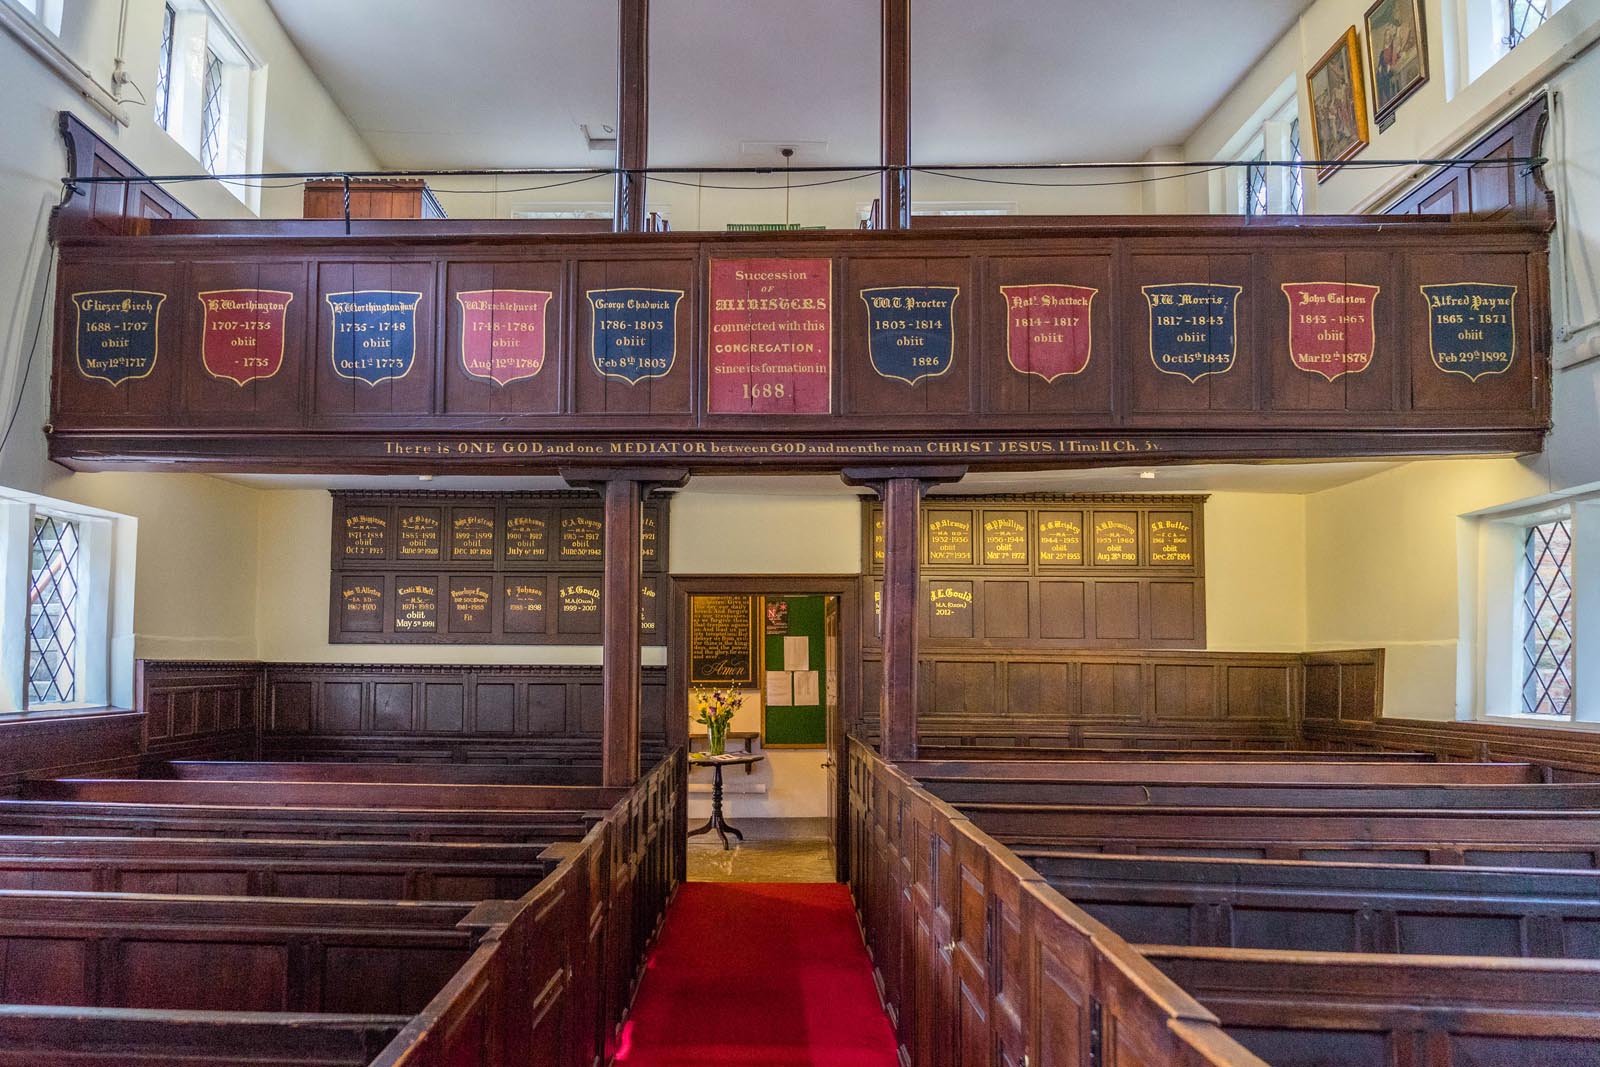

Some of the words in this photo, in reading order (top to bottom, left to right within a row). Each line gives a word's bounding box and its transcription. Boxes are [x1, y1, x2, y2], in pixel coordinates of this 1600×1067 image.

[735, 270, 808, 281] Succession
[904, 297, 948, 311] Procter
[1177, 294, 1224, 306] Morris
[1298, 291, 1326, 306] John
[1431, 294, 1470, 310] Alfred
[1471, 295, 1511, 312] Payne
[82, 299, 121, 314] Eliezer
[120, 298, 153, 314] Birch
[595, 298, 625, 312] George
[627, 299, 670, 312] Chadwick
[1478, 314, 1506, 324] 1871
[713, 321, 776, 333] connected
[778, 320, 801, 332] with
[803, 319, 825, 332] this
[1034, 332, 1064, 343] obiit
[1176, 332, 1207, 342] obiit
[1317, 329, 1345, 341] obiit
[1458, 329, 1484, 340] obiit
[101, 337, 129, 348] obiit
[231, 336, 257, 346] obiit
[363, 337, 391, 348] obiit
[492, 337, 521, 347] obiit
[615, 335, 646, 346] obiit
[896, 335, 924, 346] obiit
[598, 357, 618, 368] Feb
[1162, 353, 1183, 363] Oct
[1298, 353, 1321, 363] Mar
[1342, 353, 1368, 363] 1878
[1438, 352, 1458, 363] Feb
[86, 359, 109, 370] May
[516, 359, 539, 369] 1786
[714, 363, 745, 374] since
[762, 363, 814, 374] formation
[815, 363, 827, 374] in
[383, 442, 431, 454] There
[437, 442, 450, 454] is
[458, 442, 496, 453] ONE
[547, 443, 574, 453] and
[610, 442, 708, 453] MEDIATOR
[711, 442, 768, 453] between
[771, 443, 806, 453] GOD
[809, 442, 834, 453] and
[927, 442, 993, 453] CHRIST
[406, 611, 426, 619] obiit
[396, 619, 413, 629] May
